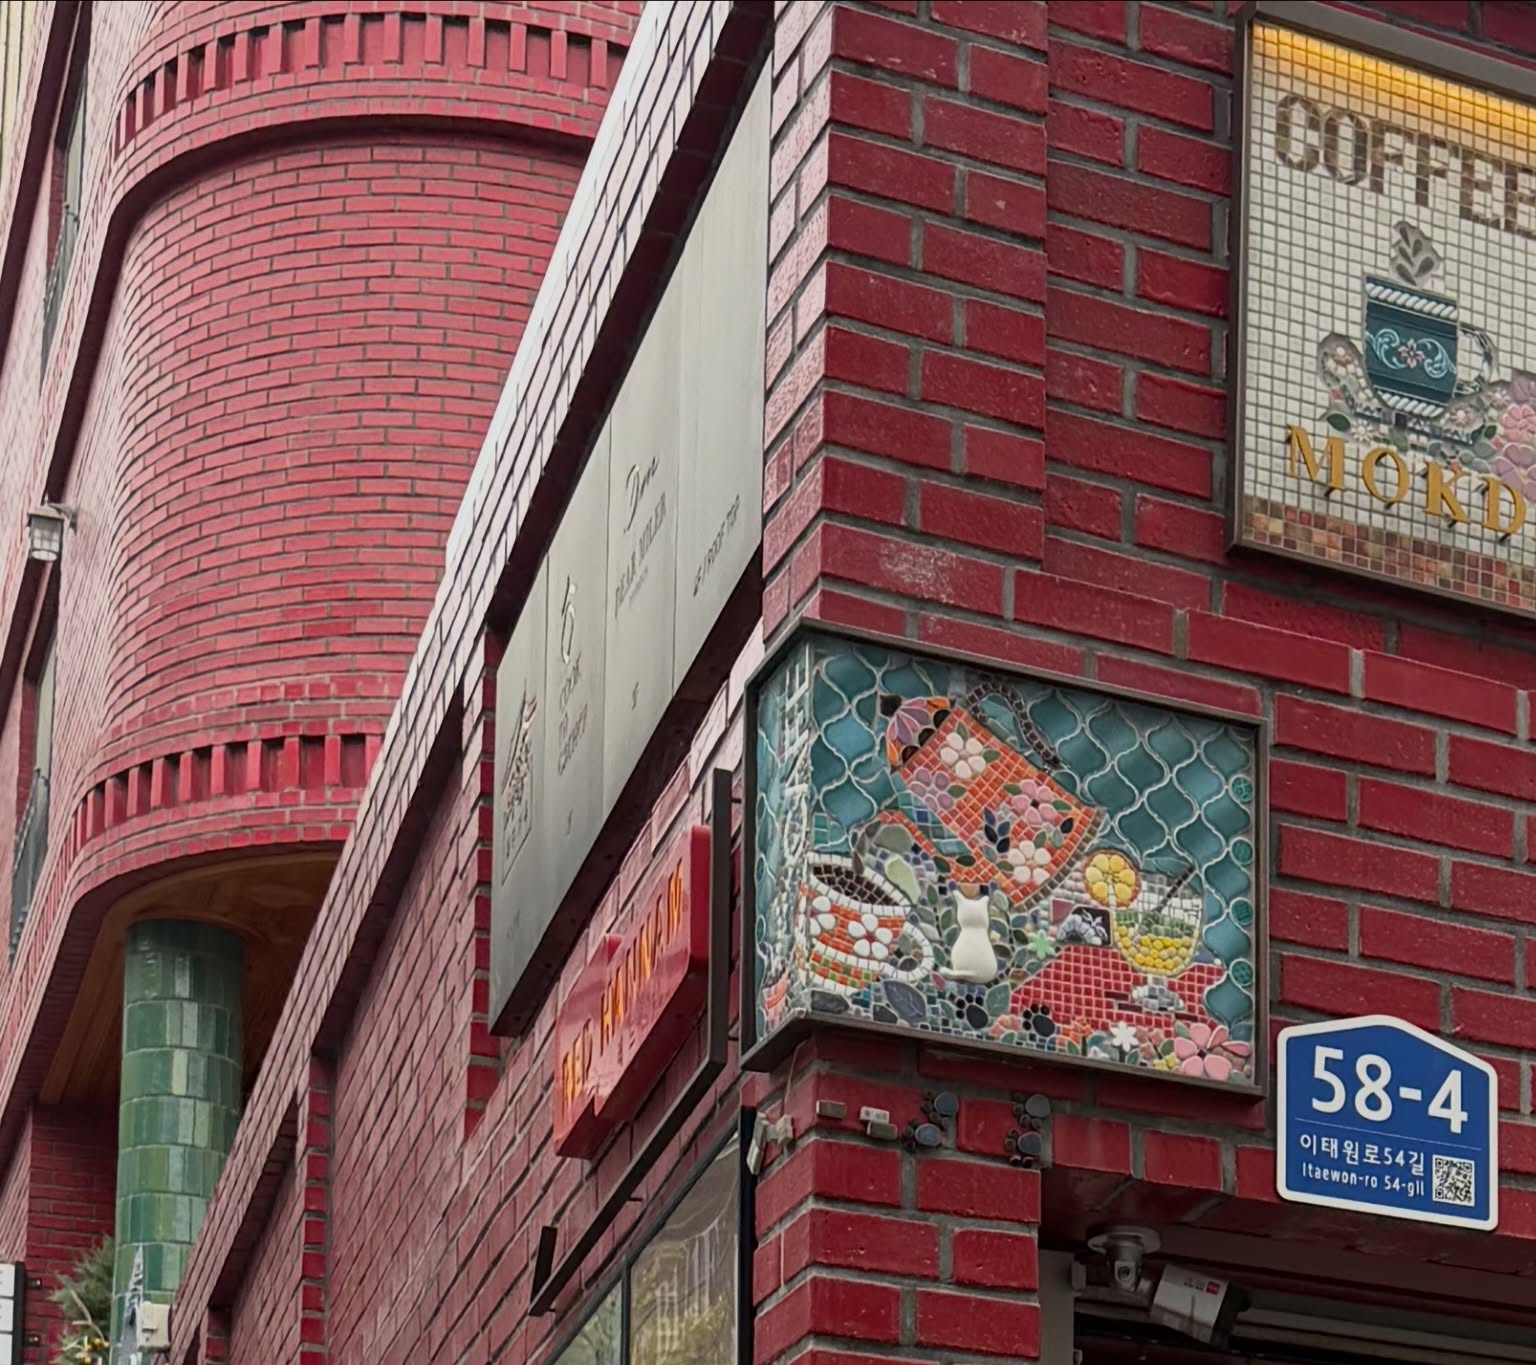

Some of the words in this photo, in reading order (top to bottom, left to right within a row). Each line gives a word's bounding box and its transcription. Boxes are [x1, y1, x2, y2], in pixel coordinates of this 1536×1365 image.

[562, 1017, 594, 1115] RED
[600, 856, 684, 1057] HANNAM
[1311, 1045, 1468, 1134] 58-4
[1299, 1133, 1425, 1177] 이태원로54길
[1302, 1162, 1378, 1189] Itaewon-ro
[1384, 1174, 1425, 1197] 54-gil
